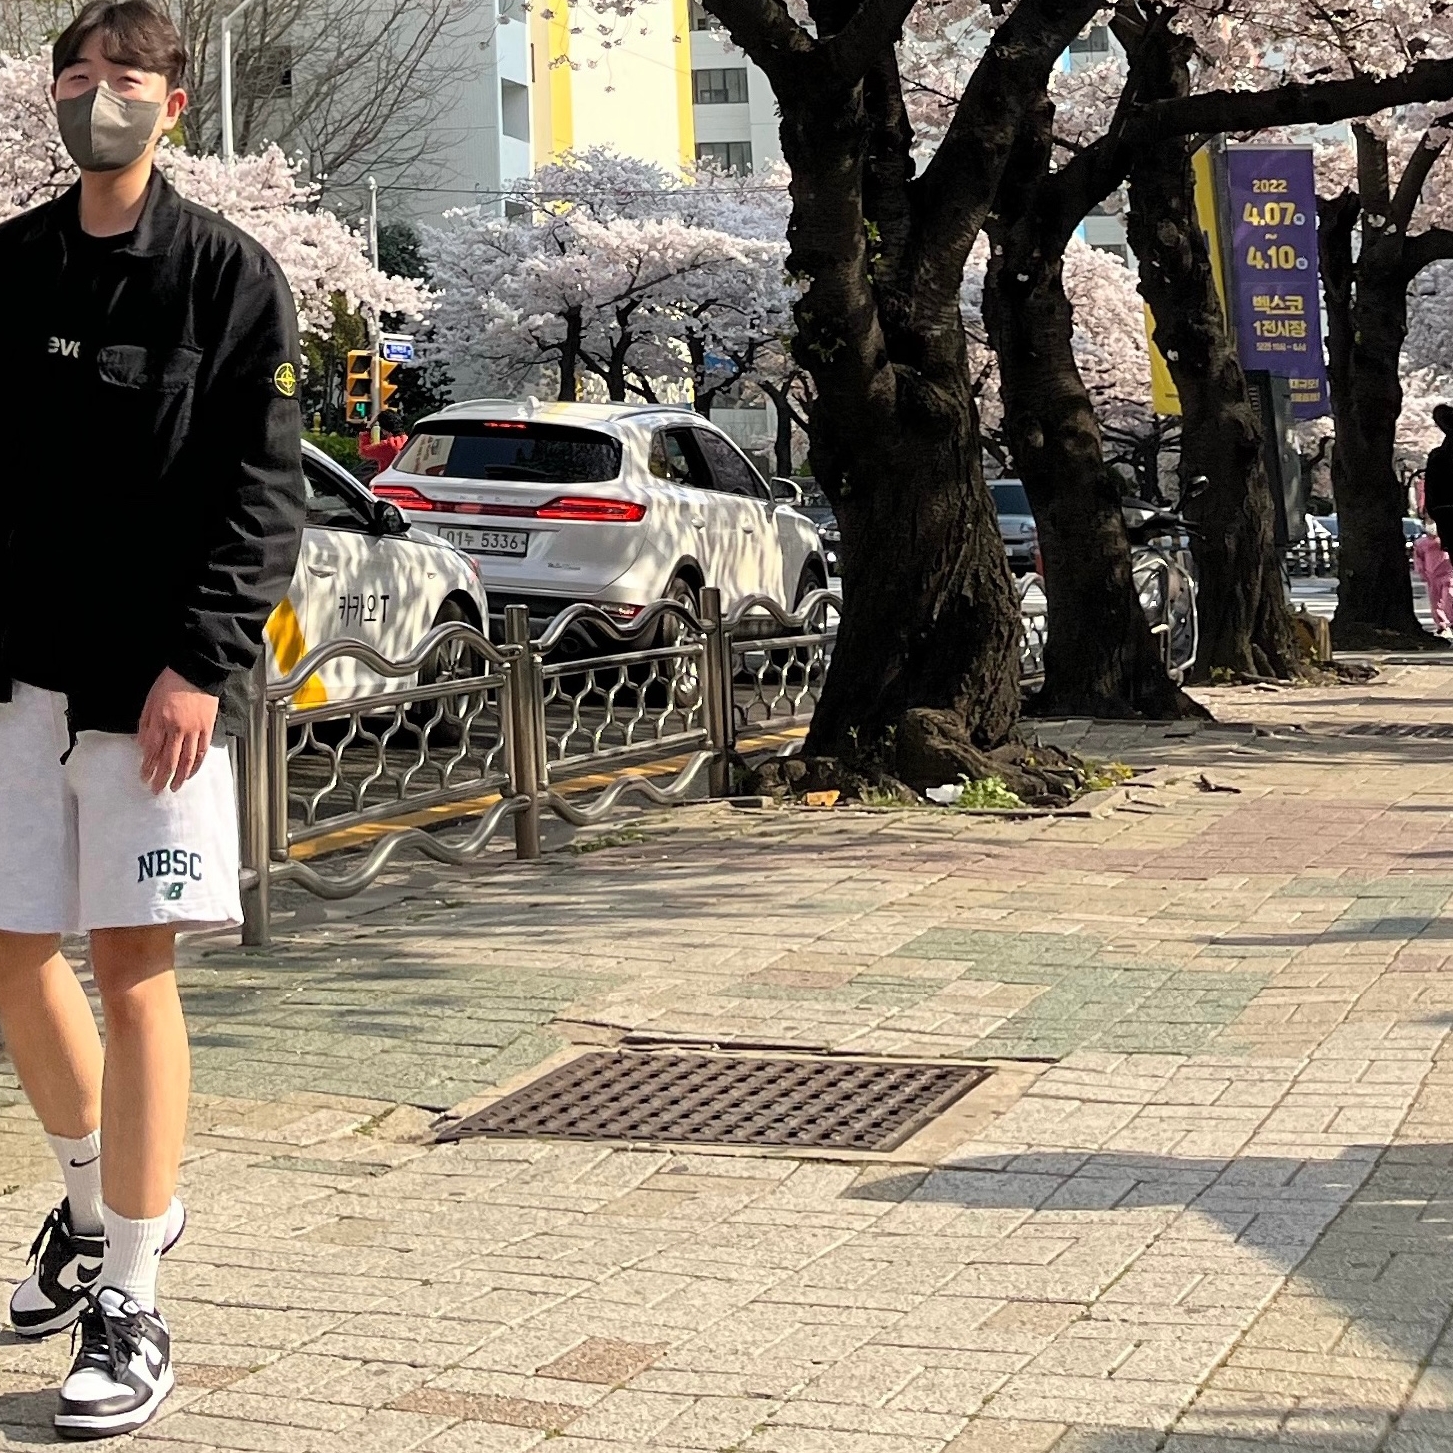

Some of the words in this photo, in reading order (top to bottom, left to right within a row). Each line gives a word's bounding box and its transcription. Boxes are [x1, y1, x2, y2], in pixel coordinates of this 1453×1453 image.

[1252, 179, 1287, 193] 2022
[1243, 201, 1296, 226] 4.07
[1247, 245, 1296, 270] 4.10
[1253, 320, 1307, 338] 1전시장
[481, 532, 518, 549] 5336
[138, 849, 203, 883] NBSC
